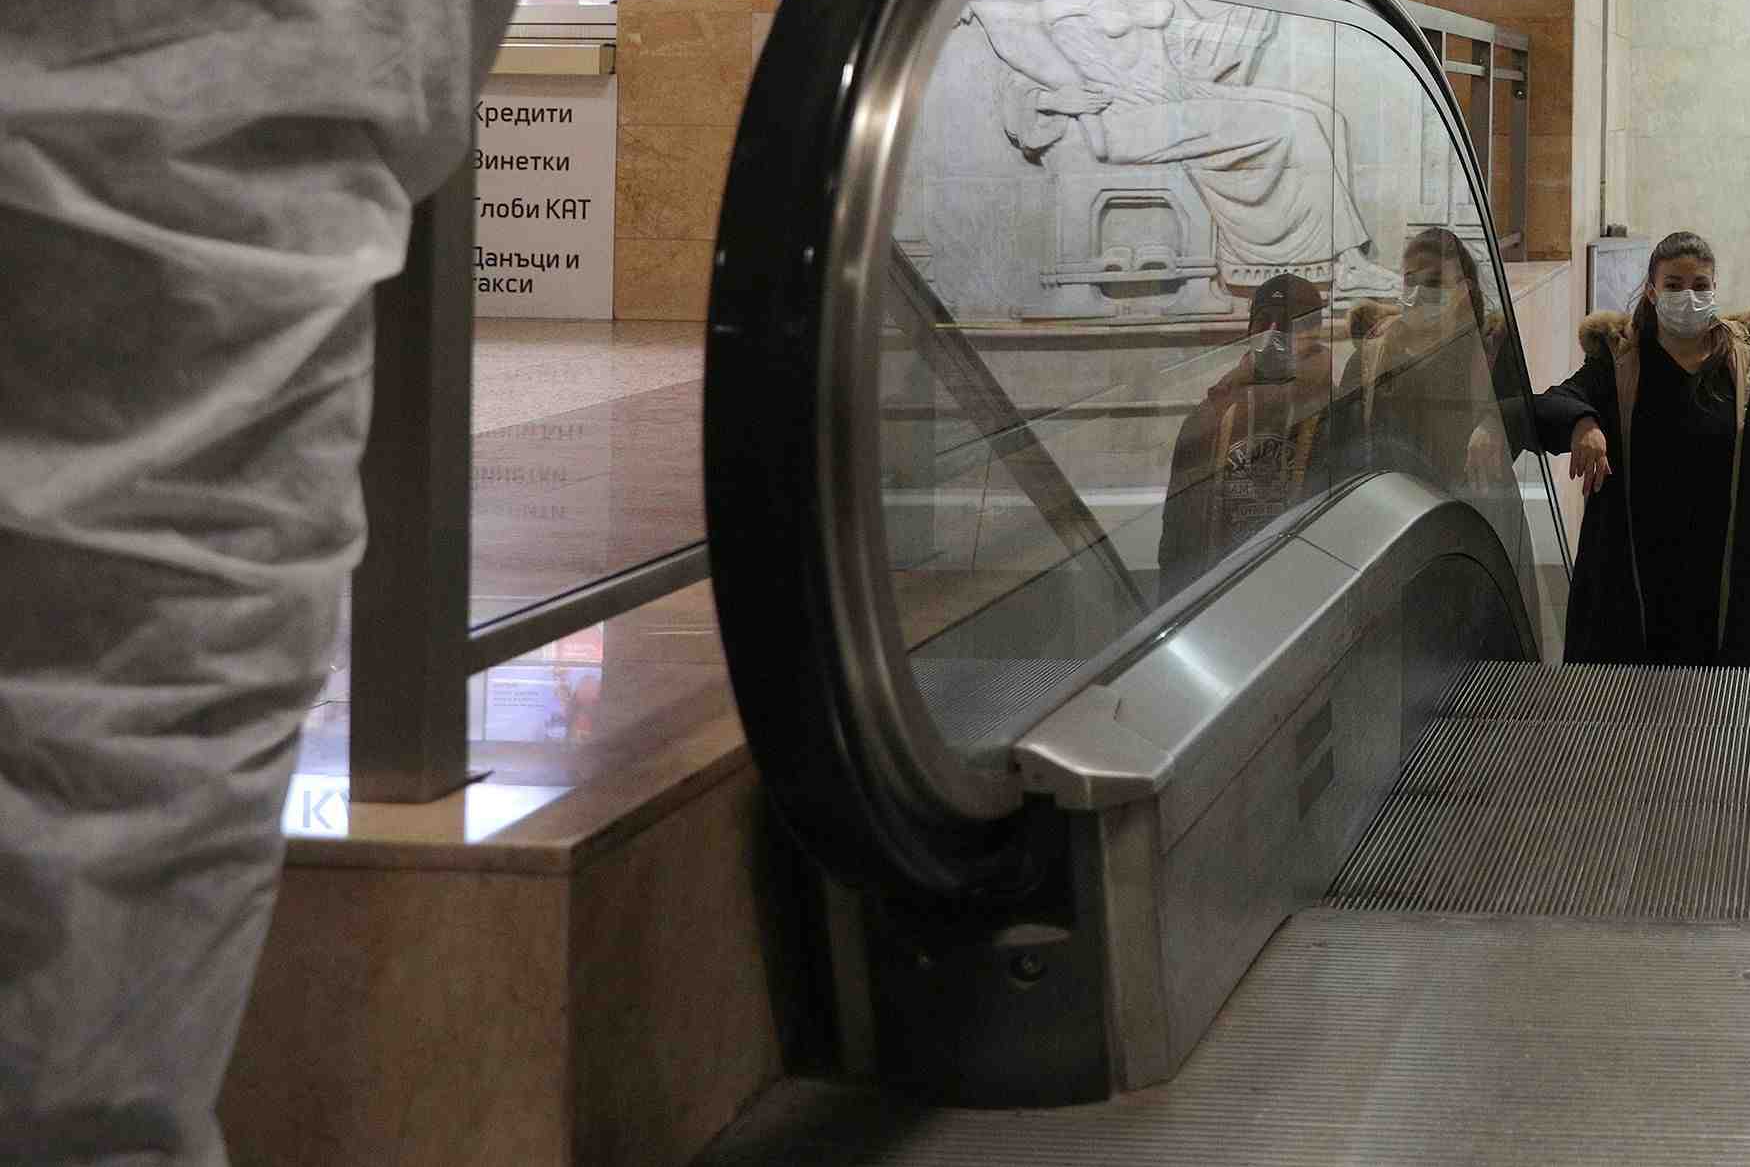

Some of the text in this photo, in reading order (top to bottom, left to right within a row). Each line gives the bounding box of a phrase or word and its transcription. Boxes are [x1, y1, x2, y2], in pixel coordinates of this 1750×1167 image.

[546, 198, 591, 220] КАТ
[566, 253, 580, 269] и
[473, 276, 533, 293] акси
